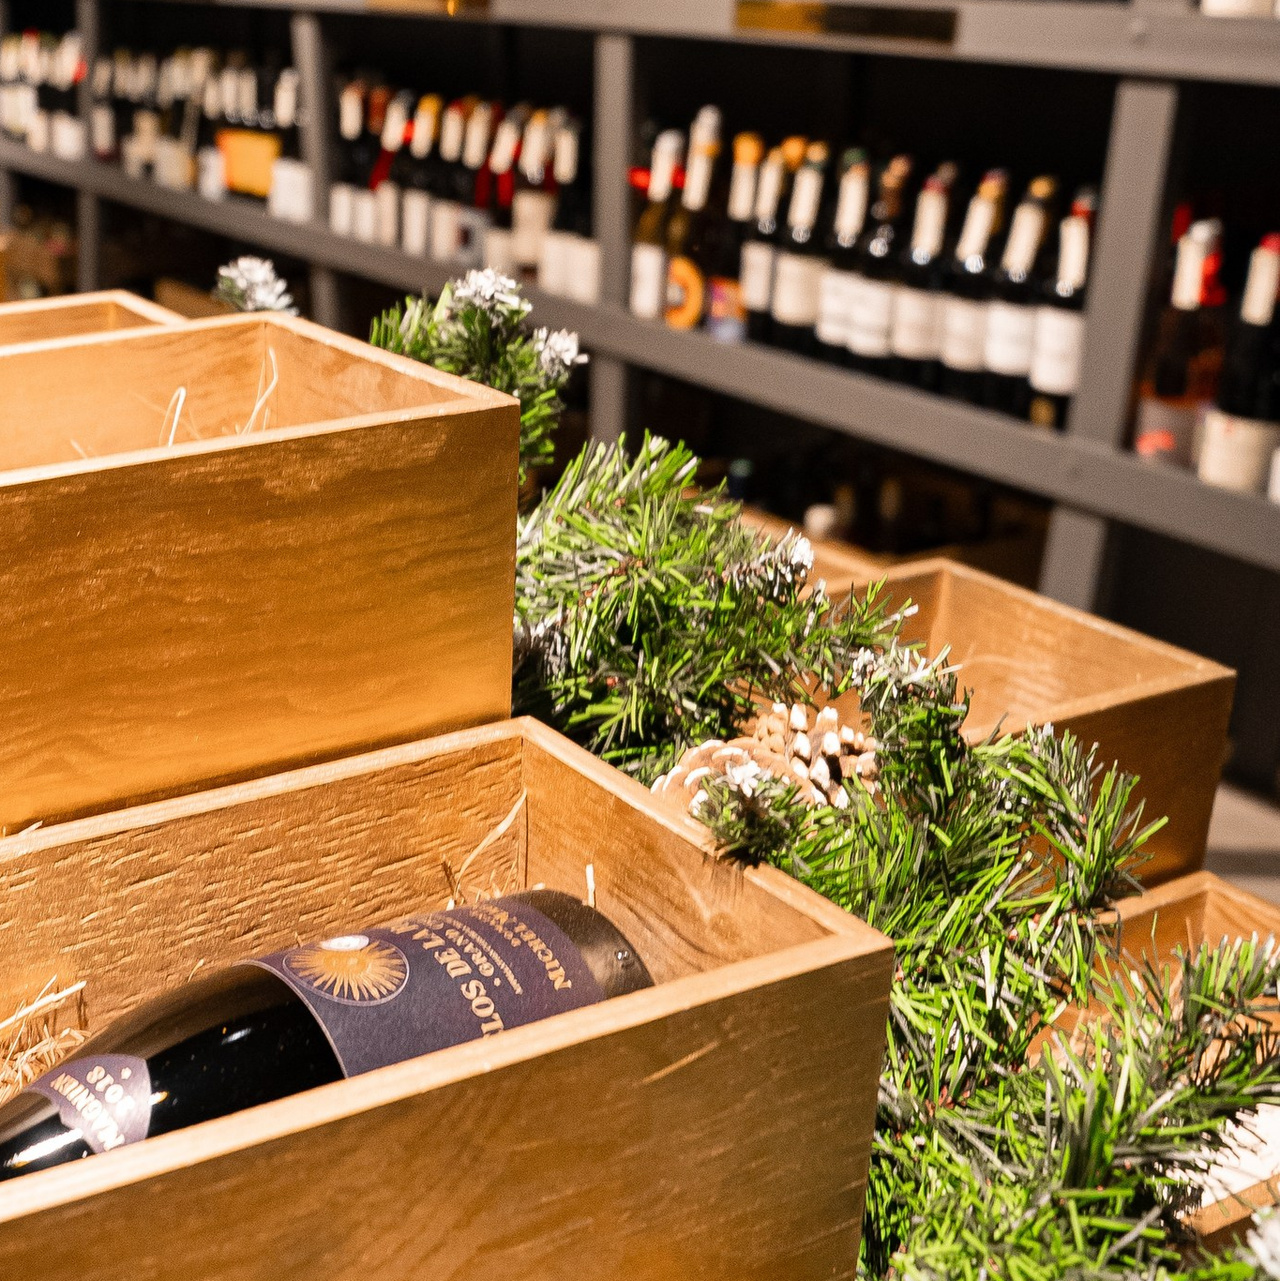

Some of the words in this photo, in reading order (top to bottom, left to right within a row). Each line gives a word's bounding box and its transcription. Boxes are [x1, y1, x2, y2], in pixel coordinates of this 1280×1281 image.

[434, 947, 472, 978] DE
[445, 928, 495, 977] GRAND
[515, 922, 572, 991] MICHEL
[460, 979, 504, 1039] LOS
[50, 1072, 125, 1152] MAGNIEN
